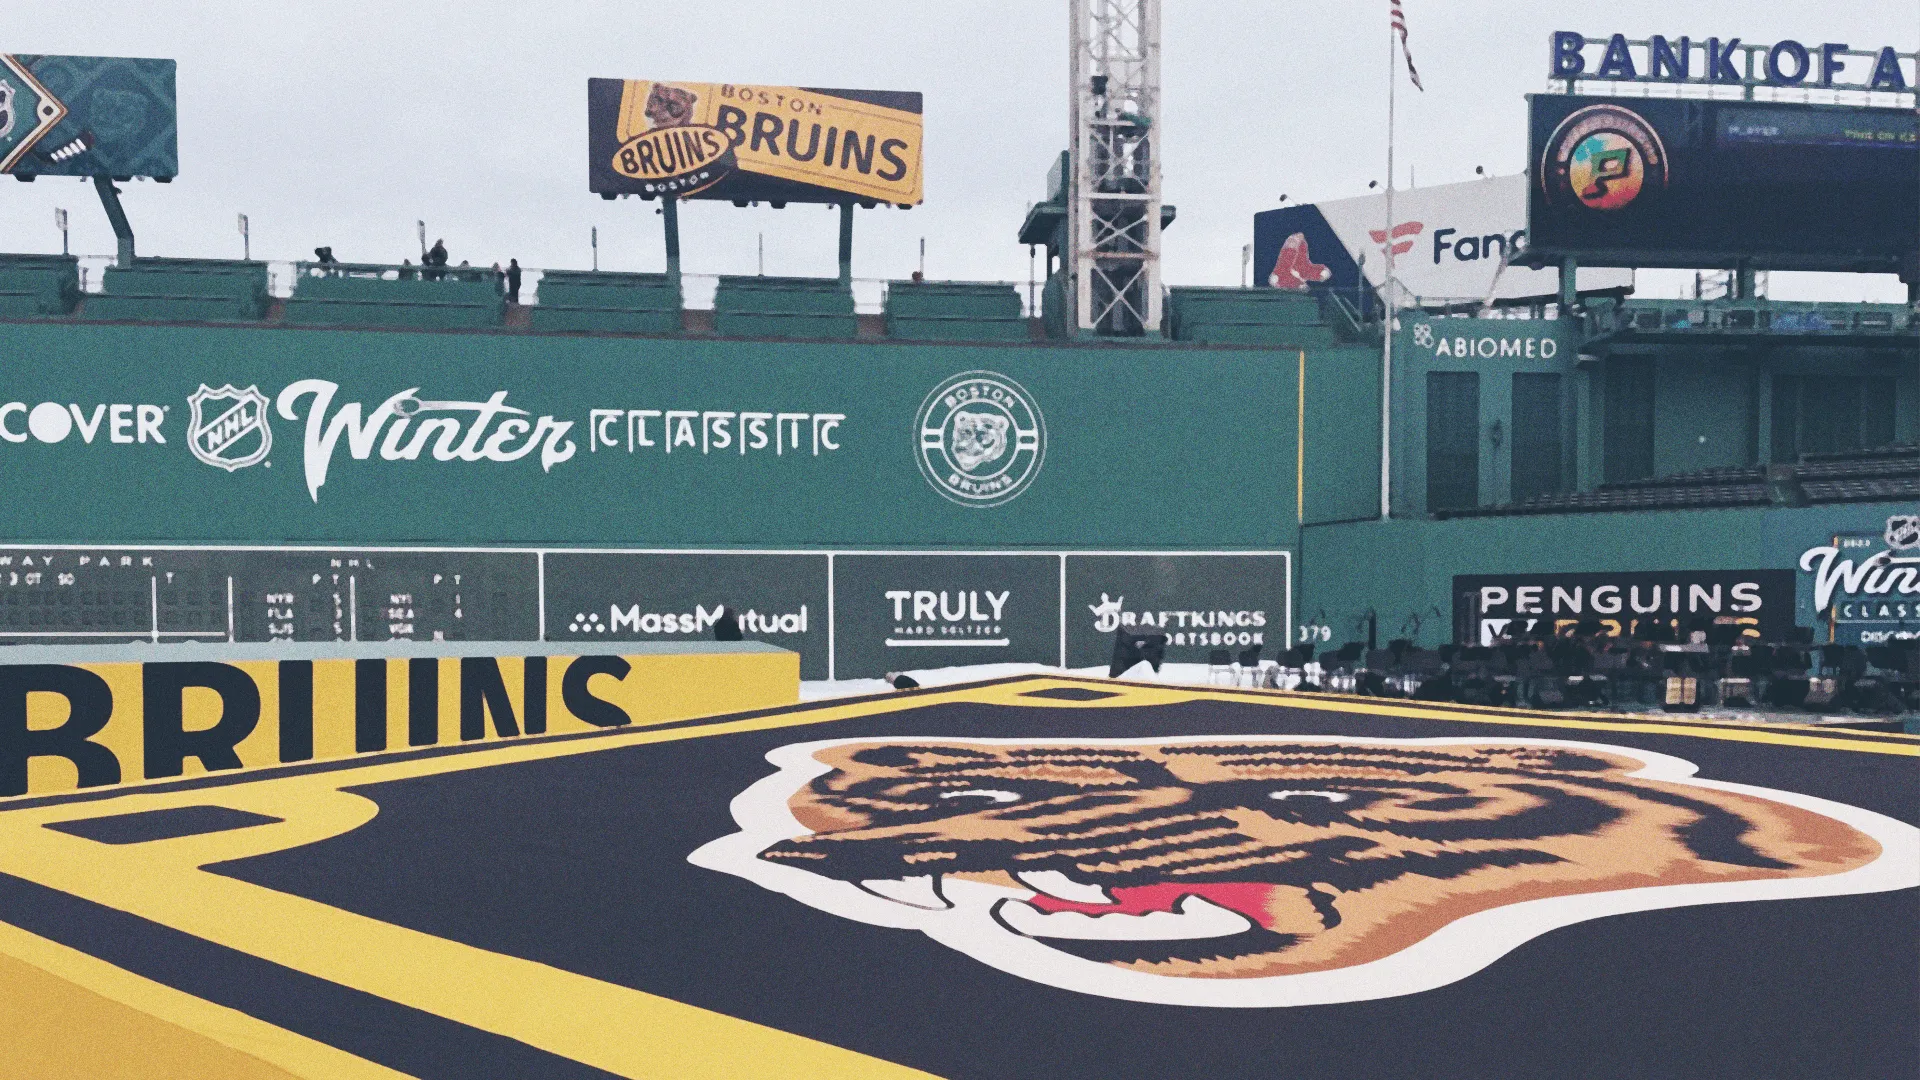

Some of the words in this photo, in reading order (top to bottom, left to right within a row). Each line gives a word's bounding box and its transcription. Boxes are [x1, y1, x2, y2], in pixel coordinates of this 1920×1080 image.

[1549, 30, 1744, 81] BANK
[1764, 39, 1850, 86] OF
[721, 84, 823, 115] BOSTON
[620, 131, 720, 175] BRUINS
[716, 104, 908, 182] BRUINS
[645, 171, 709, 192] BOSTON
[1435, 337, 1558, 359] ABIOMED
[945, 385, 1015, 408] BOSTON
[207, 406, 254, 451] NHL
[277, 379, 576, 504] Winter
[590, 409, 846, 456] CLASSIC
[948, 473, 1012, 493] BRUINS
[79, 555, 153, 567] PARK
[1800, 546, 1920, 613] Win
[885, 590, 1010, 621] TRULY
[1480, 582, 1762, 614] PENGUINS
[1094, 606, 1267, 633] DRAFTKINGS
[1298, 624, 1331, 642] 379
[0, 654, 632, 796] BRUINS
